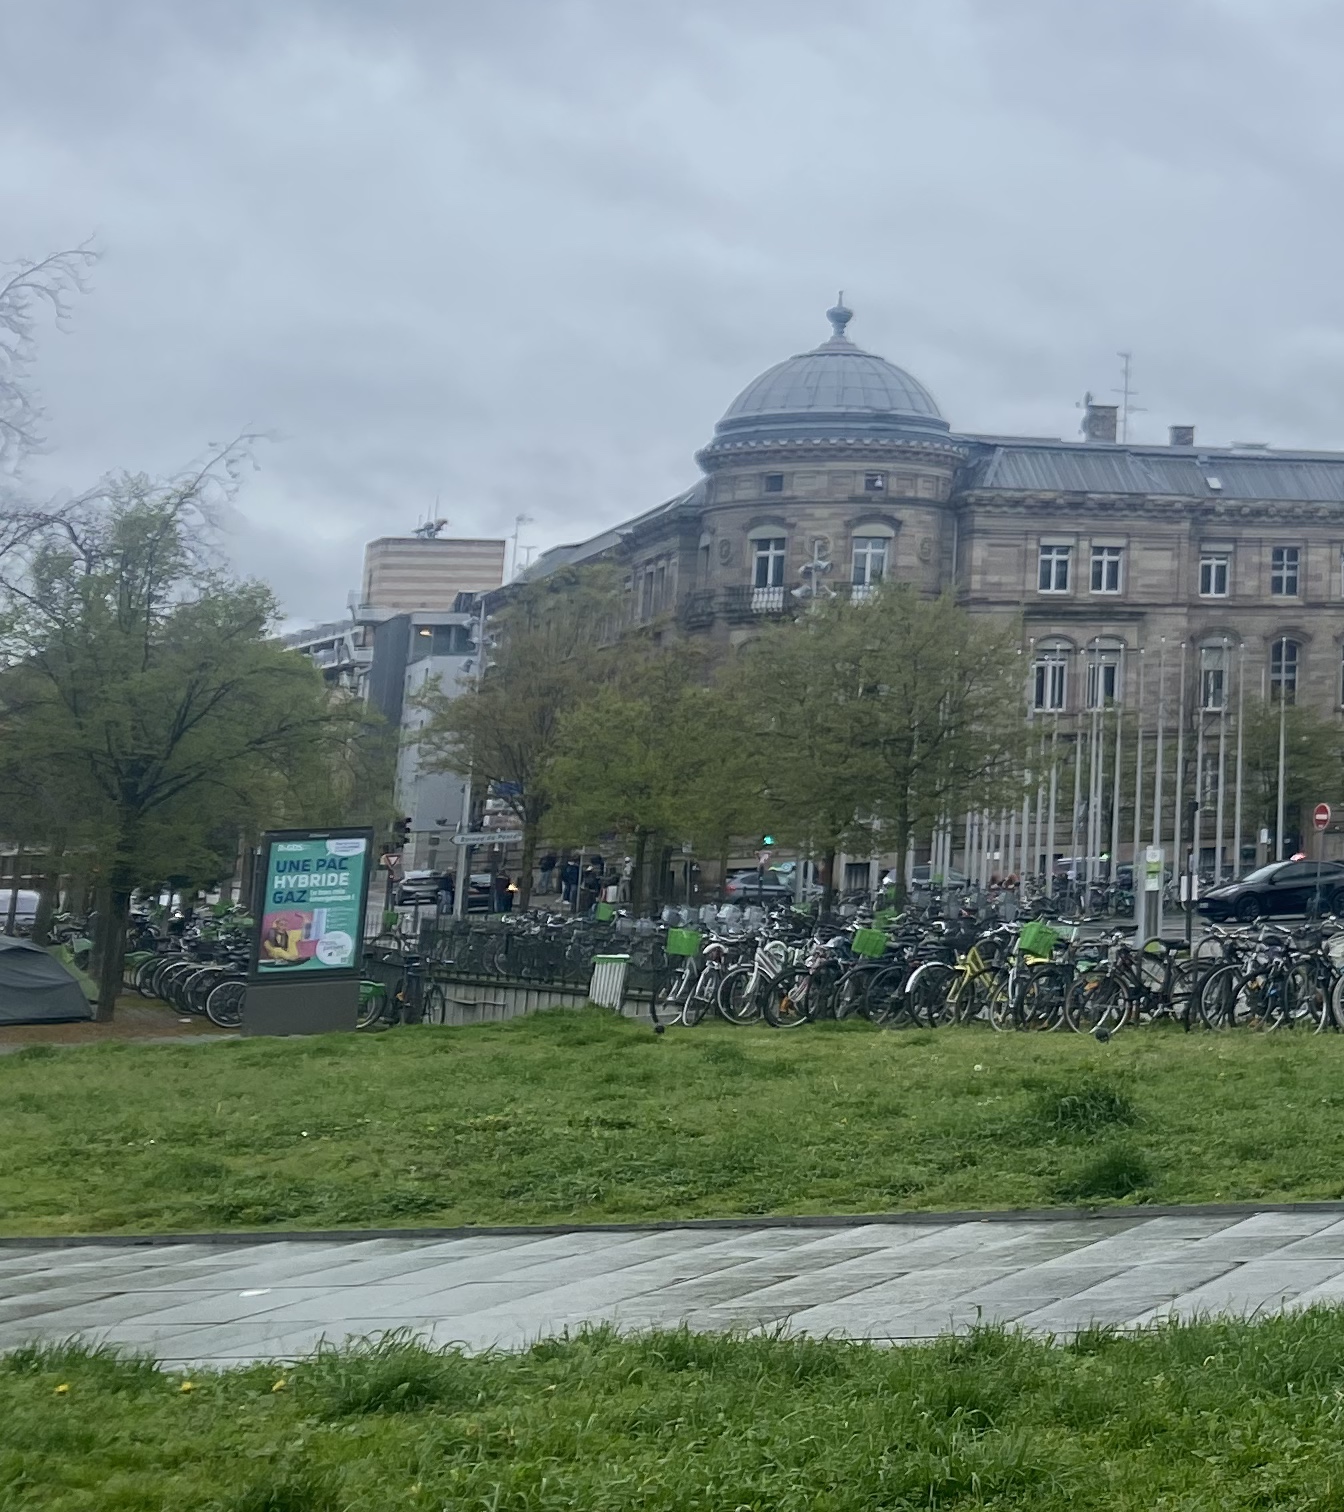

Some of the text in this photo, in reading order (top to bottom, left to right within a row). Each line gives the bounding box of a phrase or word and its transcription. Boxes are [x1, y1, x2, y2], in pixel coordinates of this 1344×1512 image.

[275, 857, 349, 873] UNE PAC
[273, 872, 350, 889] HYBRIDE
[272, 890, 307, 904] GAZ
